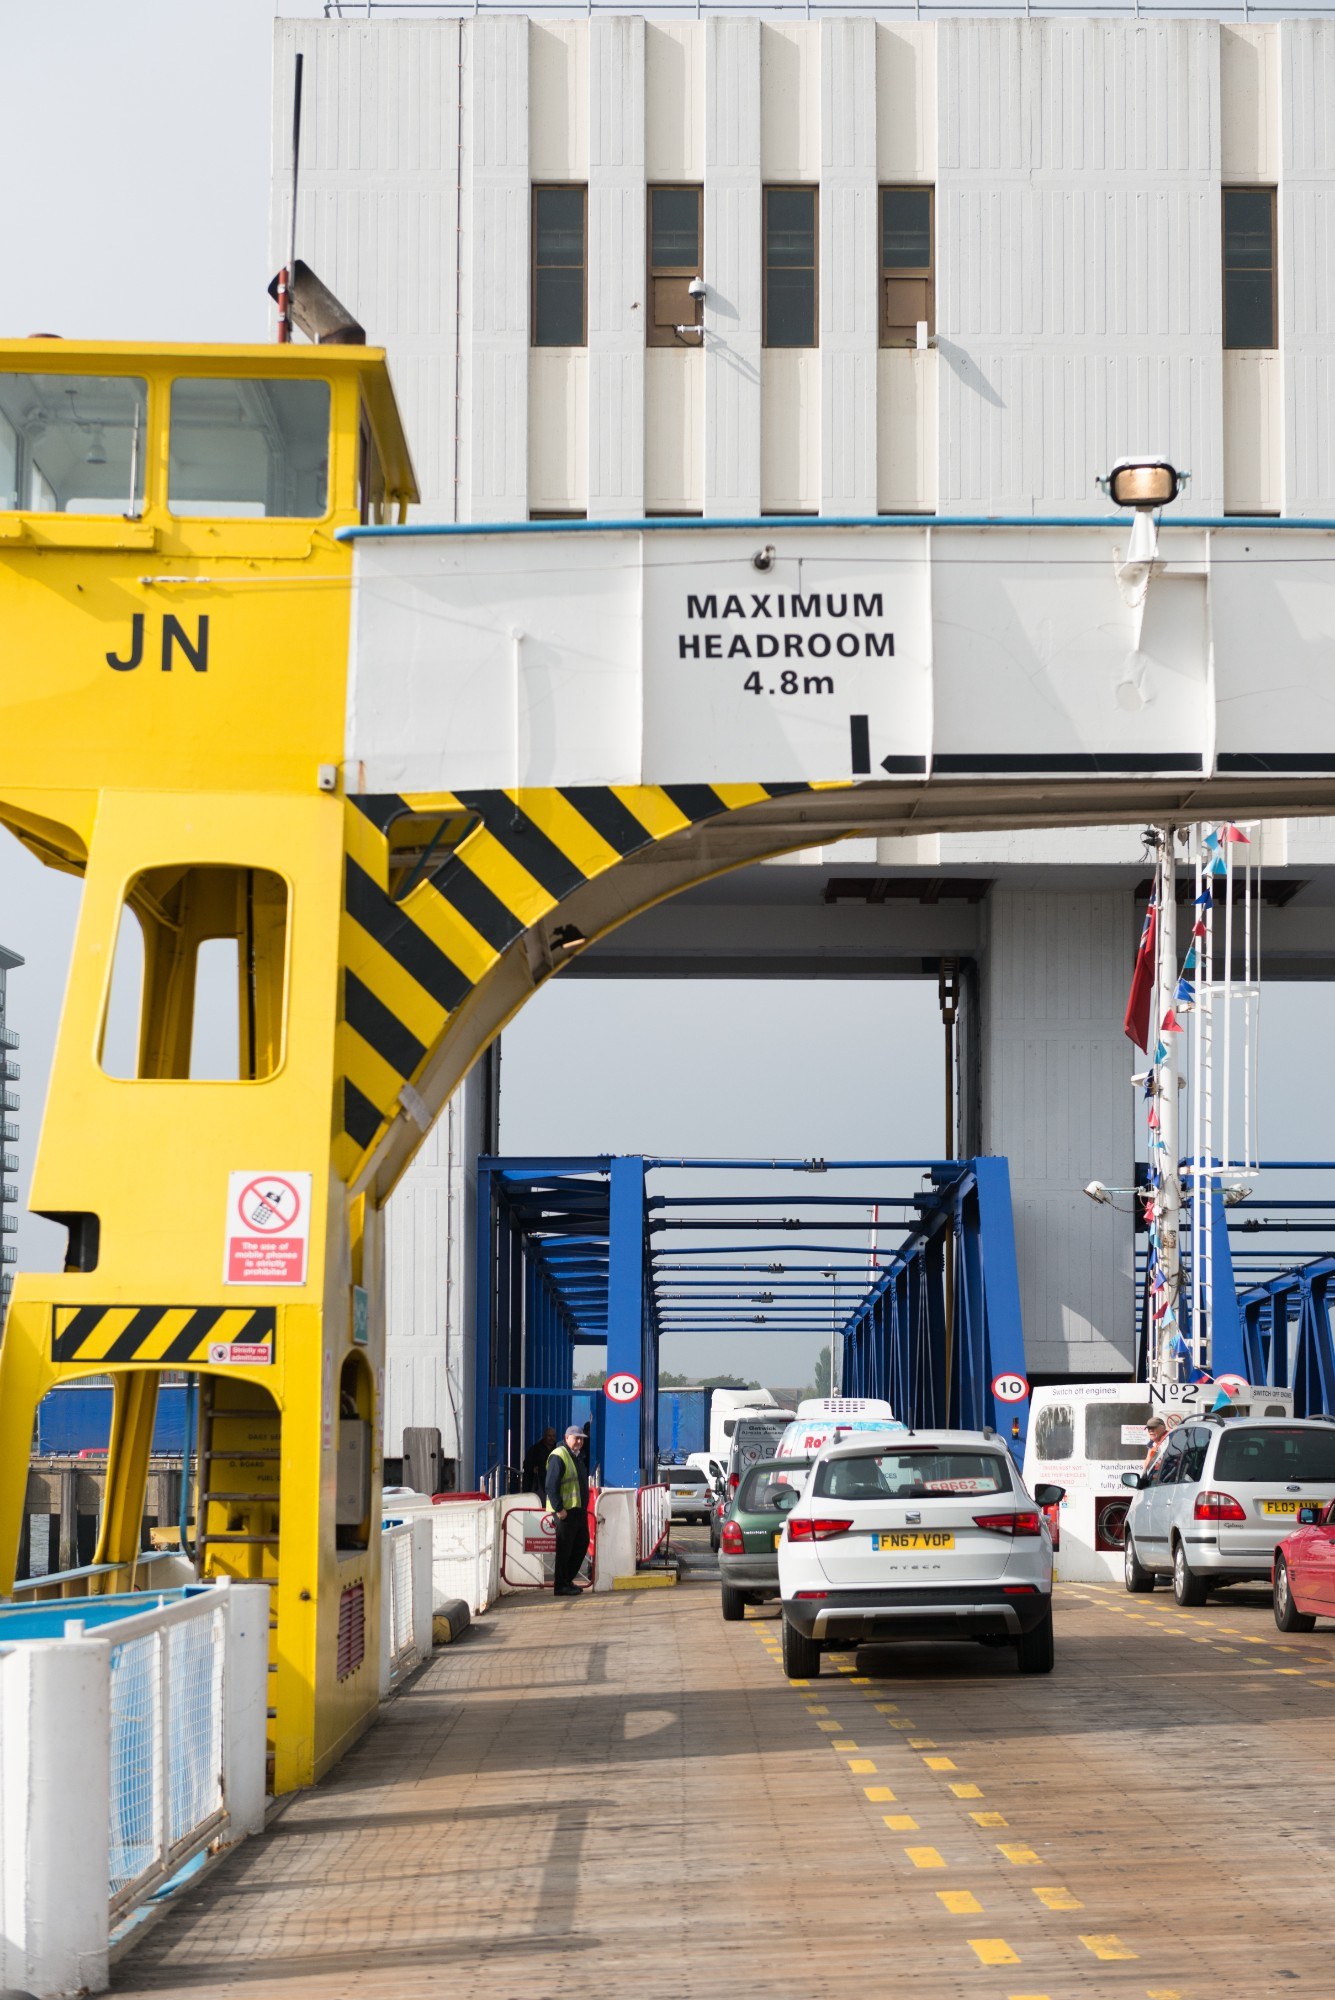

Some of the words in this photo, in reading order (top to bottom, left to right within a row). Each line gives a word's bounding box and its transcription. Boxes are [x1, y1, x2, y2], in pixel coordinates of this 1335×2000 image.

[687, 593, 884, 619] MAXIMUM
[106, 613, 209, 672] JN
[678, 633, 895, 659] HEADROOM
[743, 670, 834, 695] 4.8m
[242, 1242, 258, 1250] The
[278, 1242, 289, 1250] of
[265, 1251, 298, 1260] phones
[244, 1259, 254, 1267] is
[256, 1259, 287, 1269] strictly
[243, 1268, 288, 1277] prohibited
[613, 1382, 634, 1393] 10
[1000, 1381, 1022, 1393] 10
[1052, 1387, 1073, 1396] Switch
[1074, 1387, 1084, 1395] off
[1085, 1387, 1117, 1396] engines
[1100, 1463, 1144, 1471] Handbrakes
[1267, 1502, 1296, 1513] FL03
[881, 1533, 918, 1547] FN67
[923, 1533, 951, 1546] VOP
